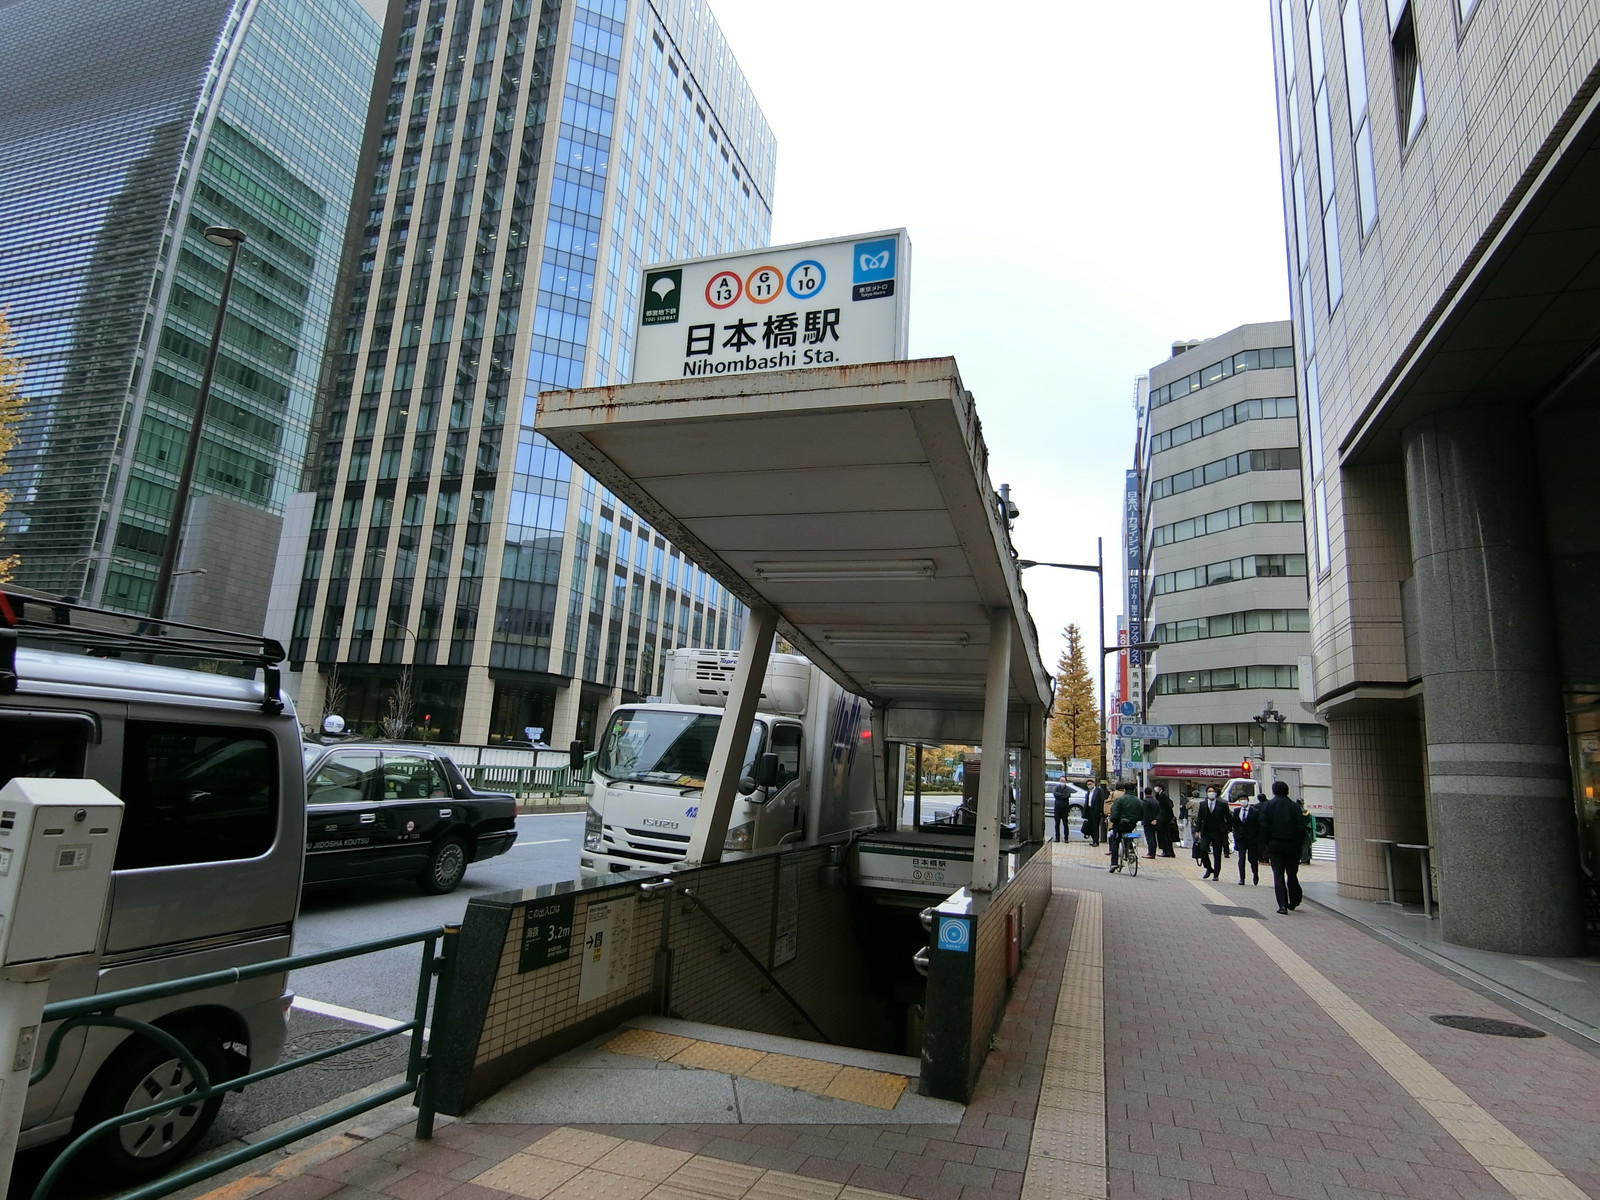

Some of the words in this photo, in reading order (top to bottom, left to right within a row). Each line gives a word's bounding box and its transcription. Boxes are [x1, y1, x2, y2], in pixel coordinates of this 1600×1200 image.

[759, 272, 770, 283] G
[803, 266, 811, 277] T
[719, 277, 729, 288] A
[798, 278, 815, 291] 10
[859, 284, 888, 293] 東京メトロ
[716, 289, 732, 302] 13
[756, 284, 771, 296] 11
[646, 307, 677, 317] 都営地下鉄
[657, 314, 676, 322] SUBWAY
[685, 308, 841, 358] 日本橋駅
[683, 350, 796, 377] Nihombashi
[803, 348, 841, 366] Sta.
[1119, 633, 1127, 656] KOO
[1199, 767, 1230, 777] 成城石井
[643, 818, 679, 830] ISUZU
[313, 839, 343, 849] JIDOSHA
[343, 836, 370, 846] KOUTSU
[912, 858, 947, 868] 日本橋駅
[528, 904, 561, 919] この出入口は
[547, 924, 571, 942] 3.2m
